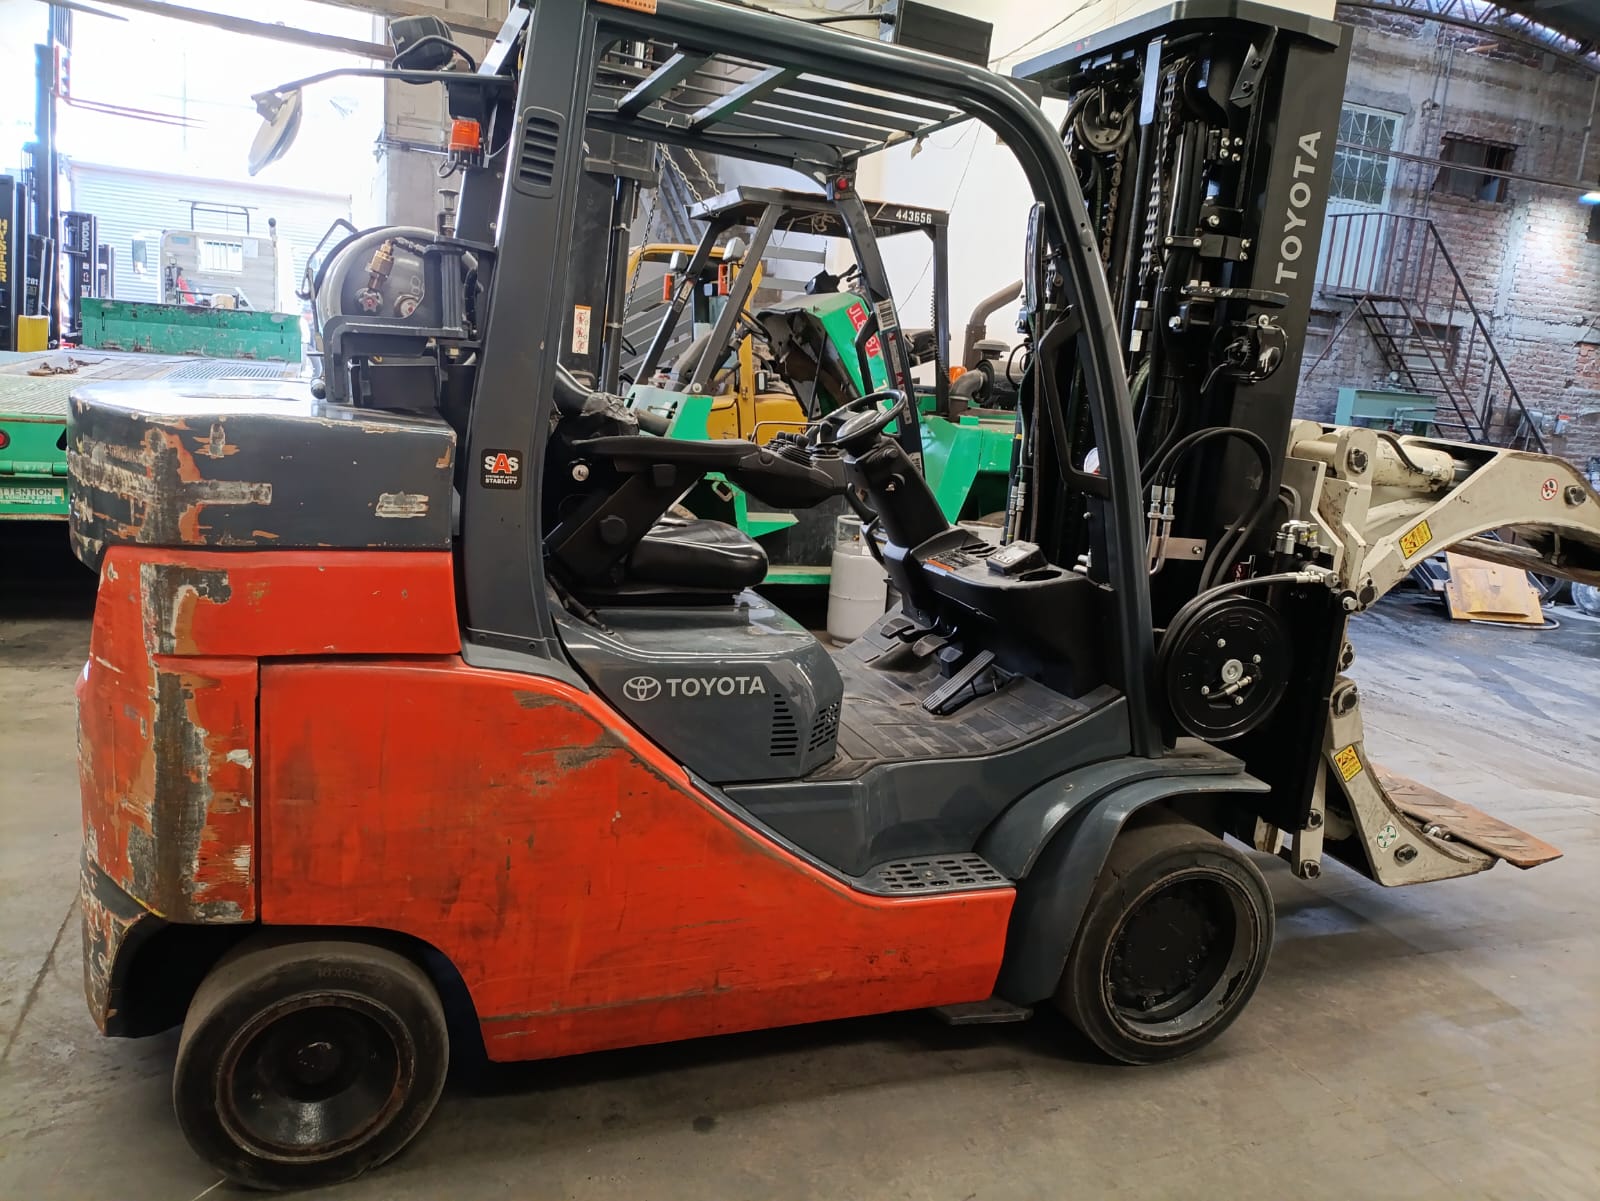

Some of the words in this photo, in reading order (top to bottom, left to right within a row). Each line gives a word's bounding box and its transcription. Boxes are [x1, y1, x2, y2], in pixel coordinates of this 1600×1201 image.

[896, 208, 932, 224] 443656
[1275, 131, 1322, 284] TOYOTA
[484, 453, 519, 474] SAS
[665, 675, 766, 697] TOYOTA
